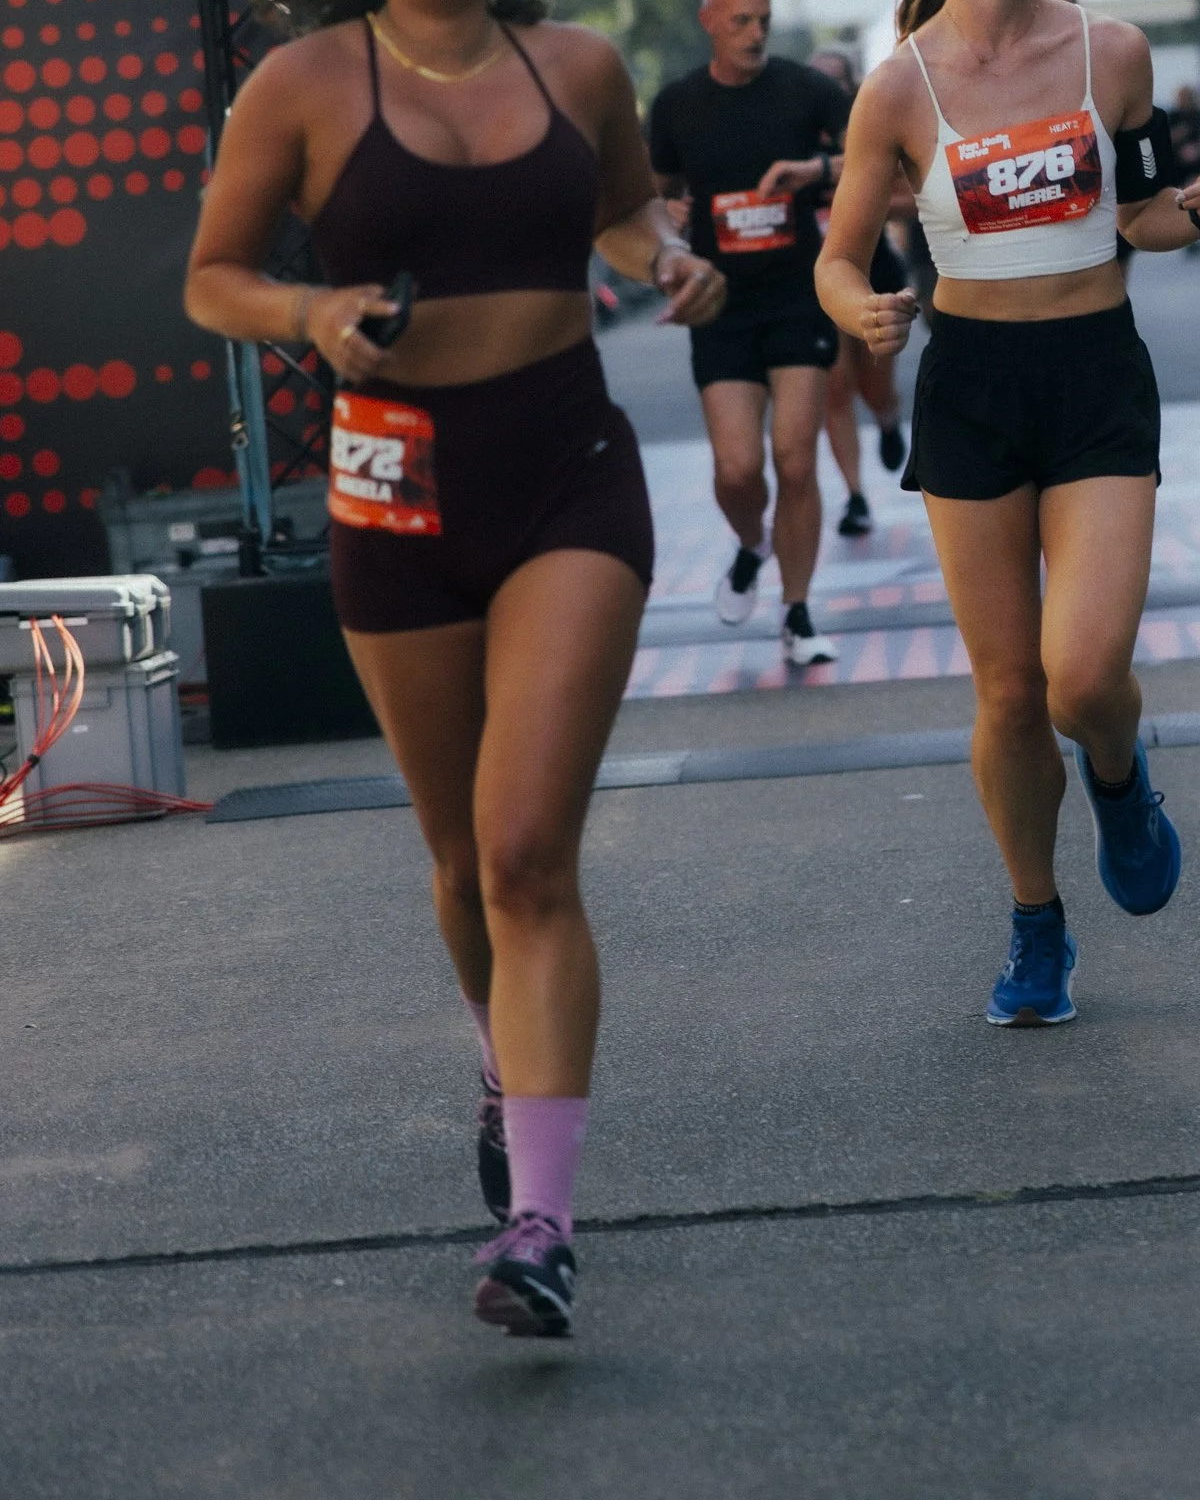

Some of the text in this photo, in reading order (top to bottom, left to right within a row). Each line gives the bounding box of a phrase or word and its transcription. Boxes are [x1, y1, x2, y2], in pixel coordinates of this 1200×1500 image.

[1049, 123, 1071, 134] HEAT
[987, 144, 1075, 196] 876
[1008, 184, 1065, 210] MEREL
